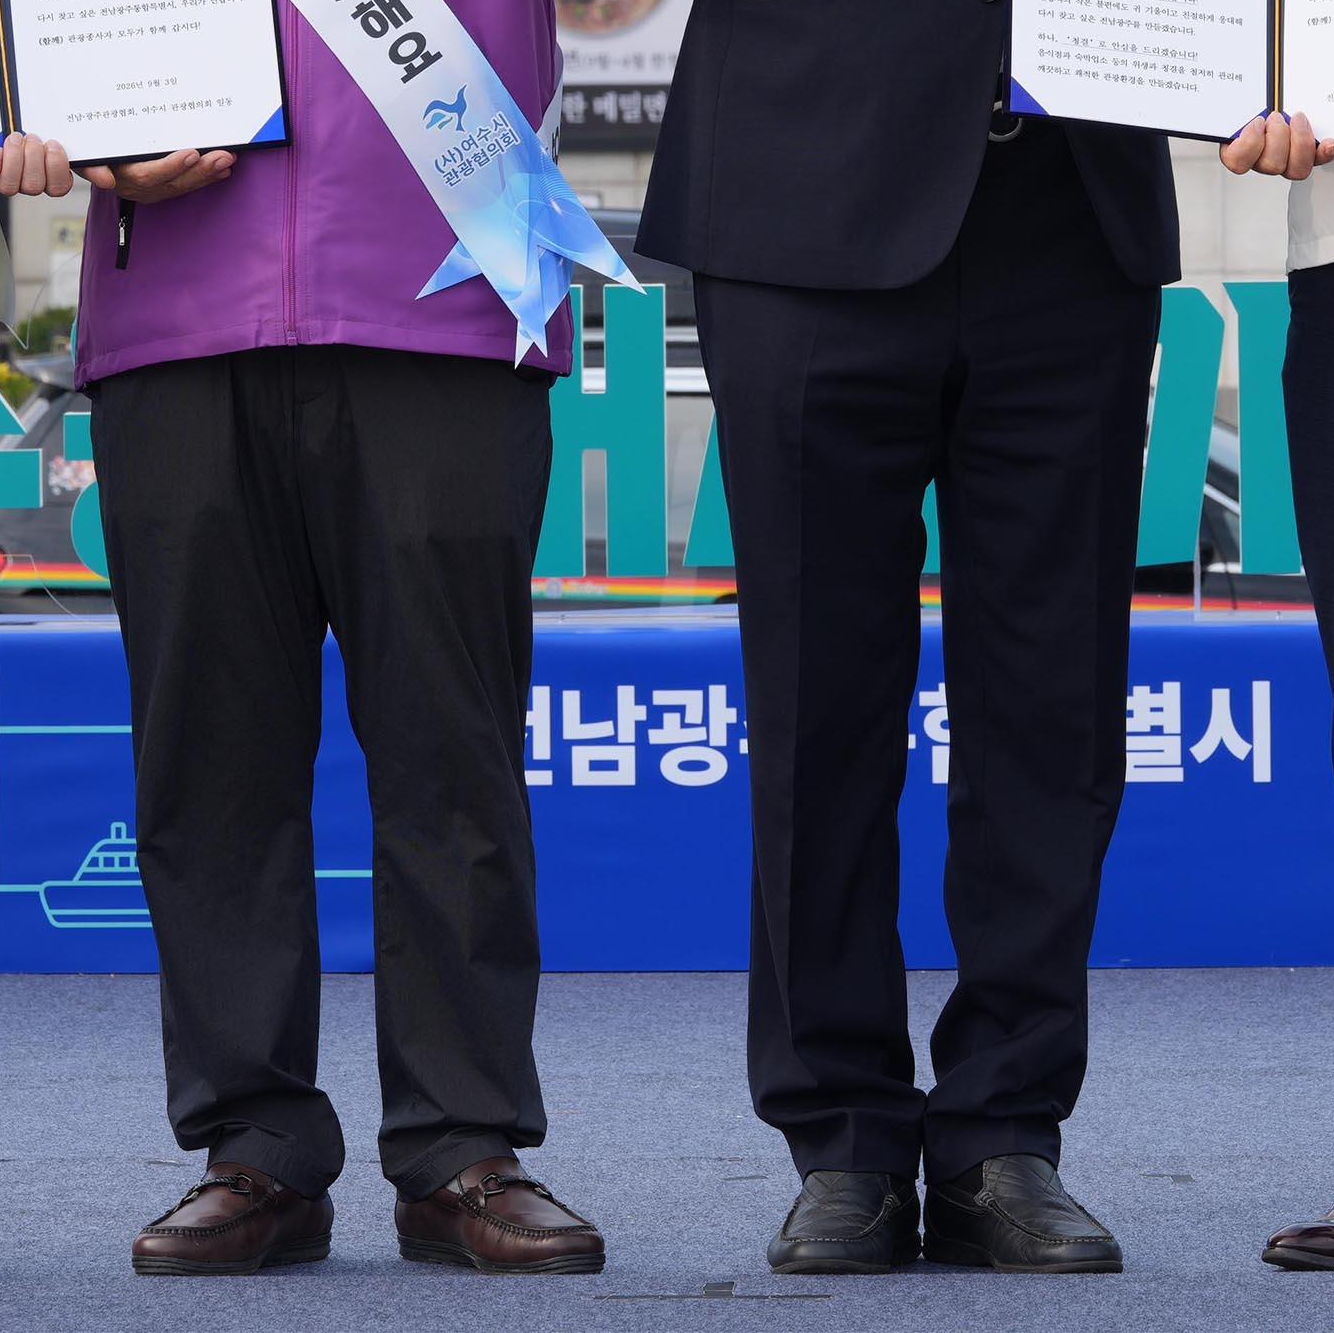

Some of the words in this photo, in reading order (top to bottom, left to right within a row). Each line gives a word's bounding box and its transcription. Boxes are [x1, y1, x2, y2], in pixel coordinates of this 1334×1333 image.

[36, 12, 54, 22] 다시
[58, 11, 75, 20] 찾고
[78, 8, 96, 18] 싶은
[67, 30, 112, 43] 관광종사자
[117, 27, 144, 37] 모두가
[148, 25, 167, 34] 함께
[115, 81, 143, 90] 2026년
[146, 79, 160, 87] 9월
[164, 76, 177, 85] 3일
[1037, 64, 1071, 75] 깨끗하고
[1074, 68, 1099, 79] 쾌적한
[1103, 72, 1145, 85] 관광환경을
[1147, 78, 1199, 92] 만들겠습니다.
[433, 112, 510, 175] (사)여수시
[441, 129, 522, 189] 관광협의회
